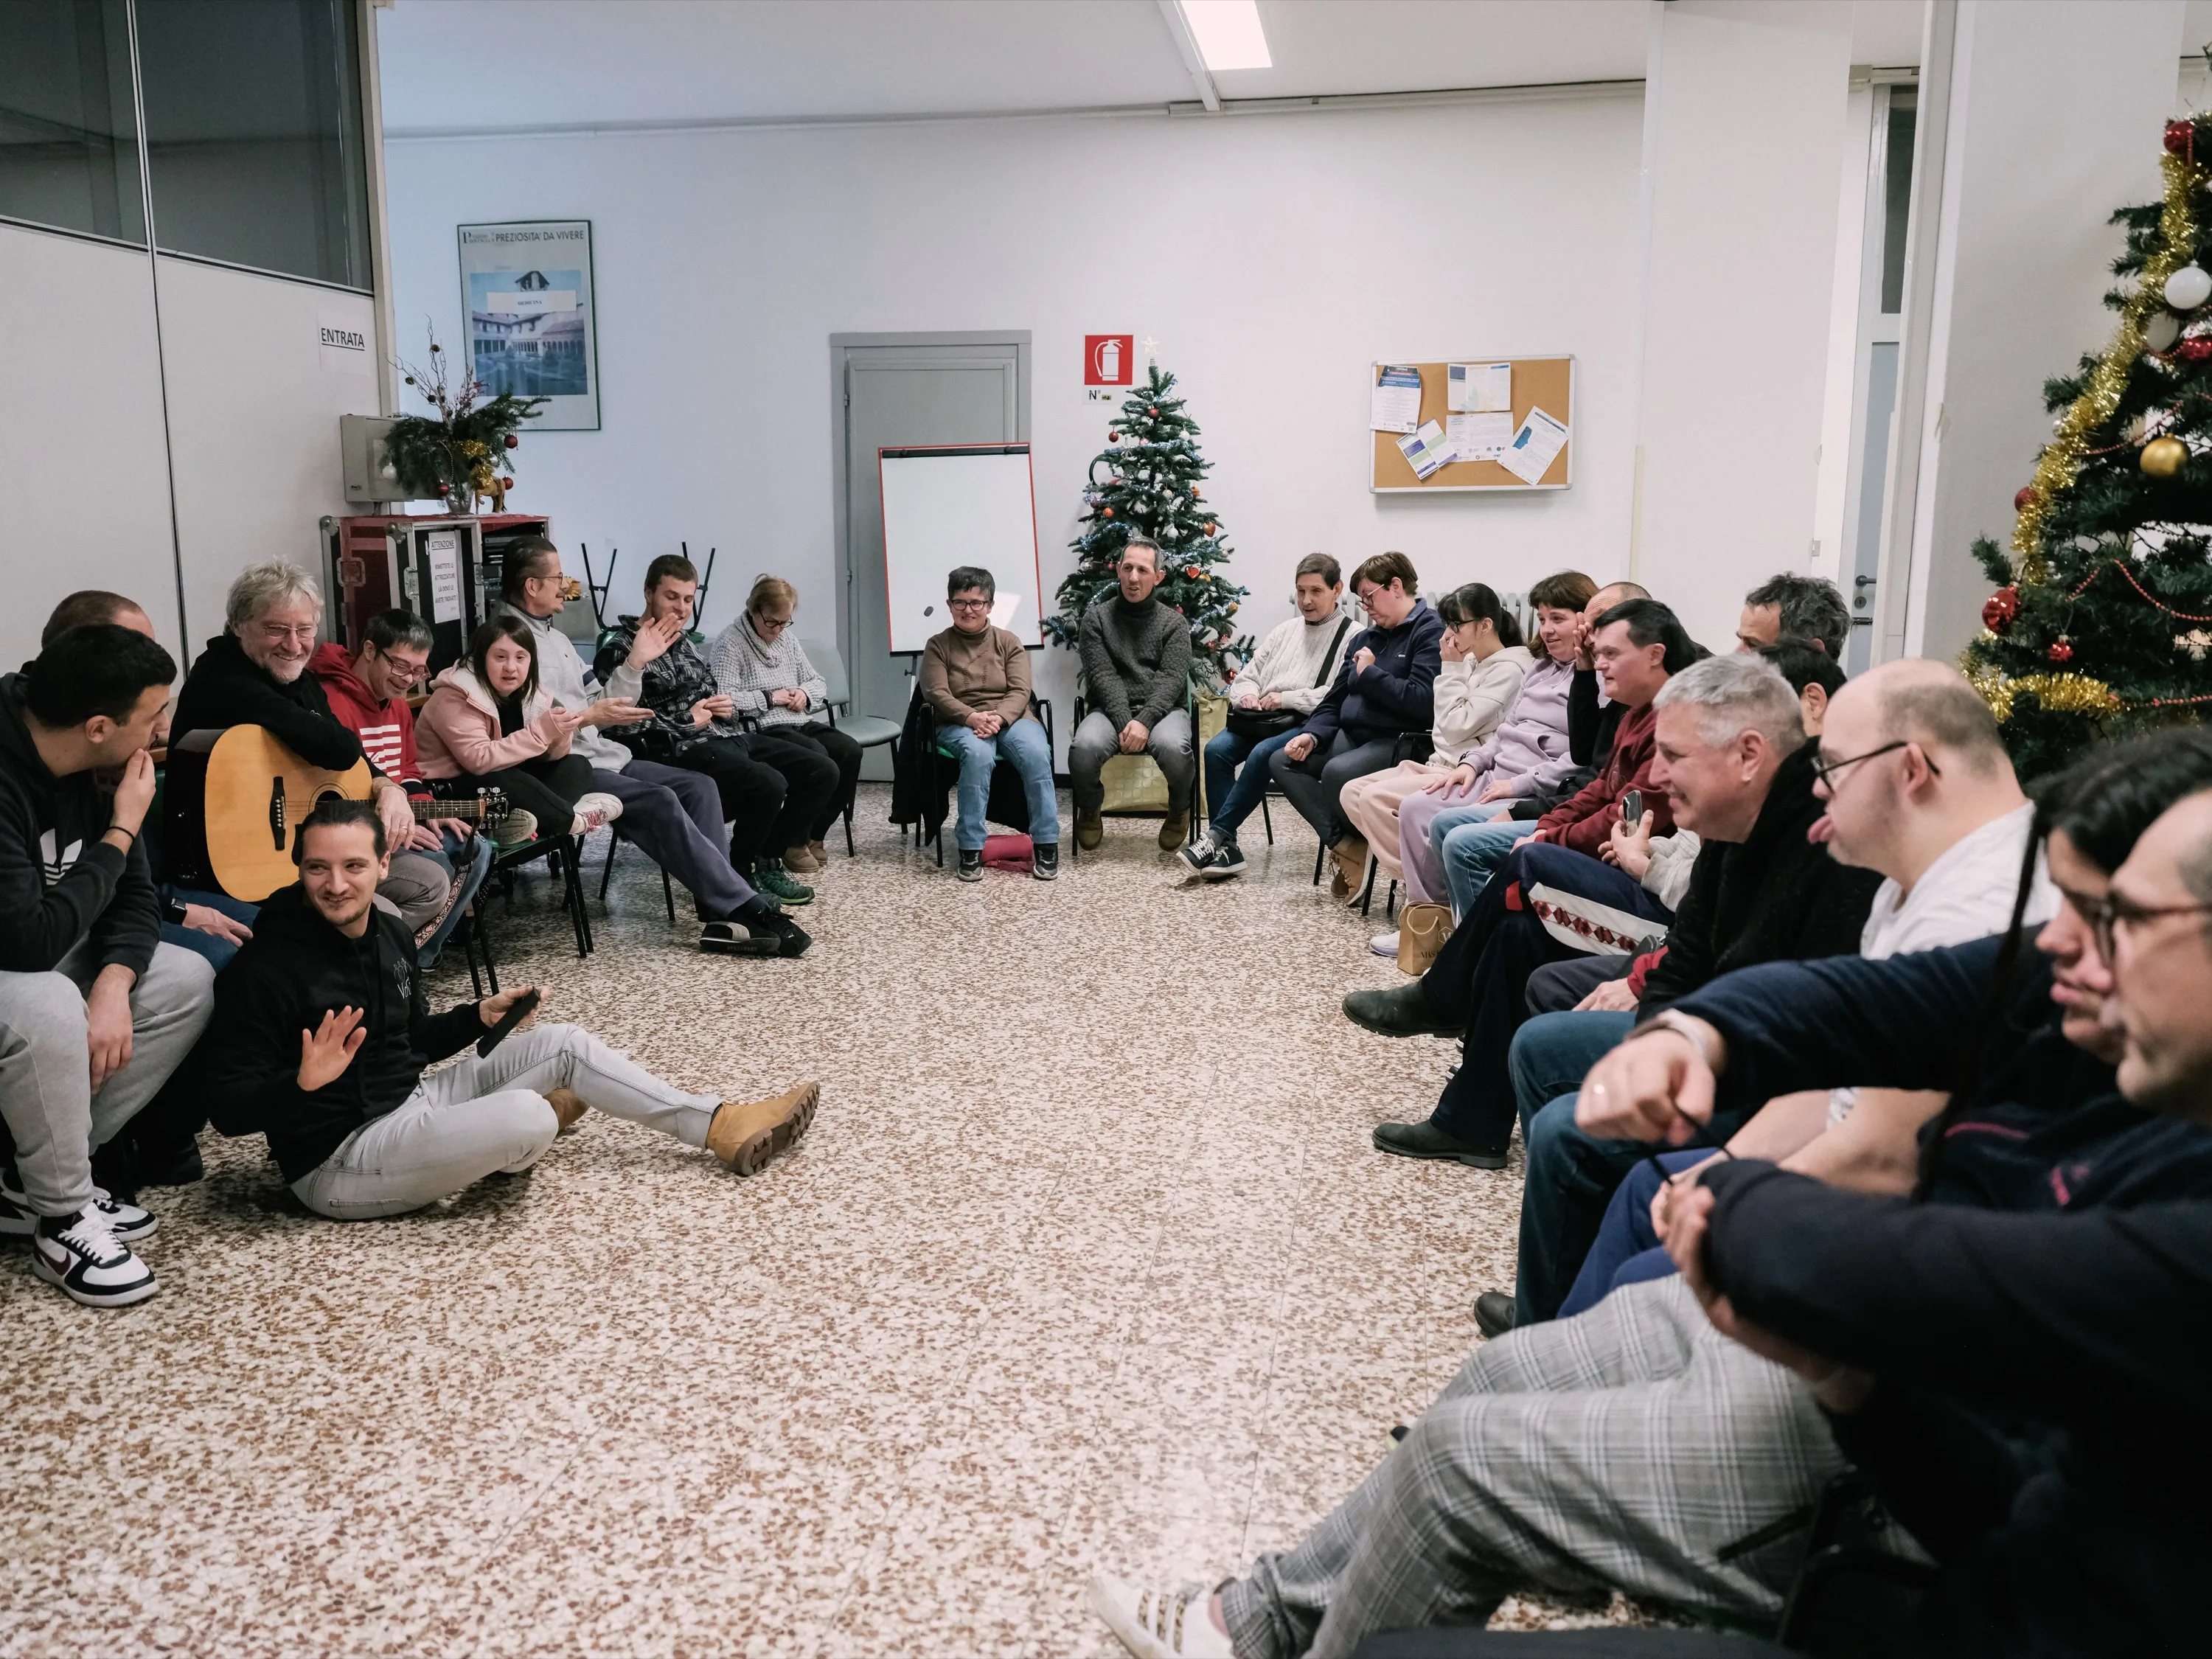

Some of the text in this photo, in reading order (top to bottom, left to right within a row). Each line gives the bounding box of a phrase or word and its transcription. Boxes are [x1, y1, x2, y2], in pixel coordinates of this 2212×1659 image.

[543, 232, 554, 240] DA
[557, 230, 584, 240] VIVERE
[321, 327, 365, 348] ENTRATA
[431, 540, 454, 548] ATTENZIONE
